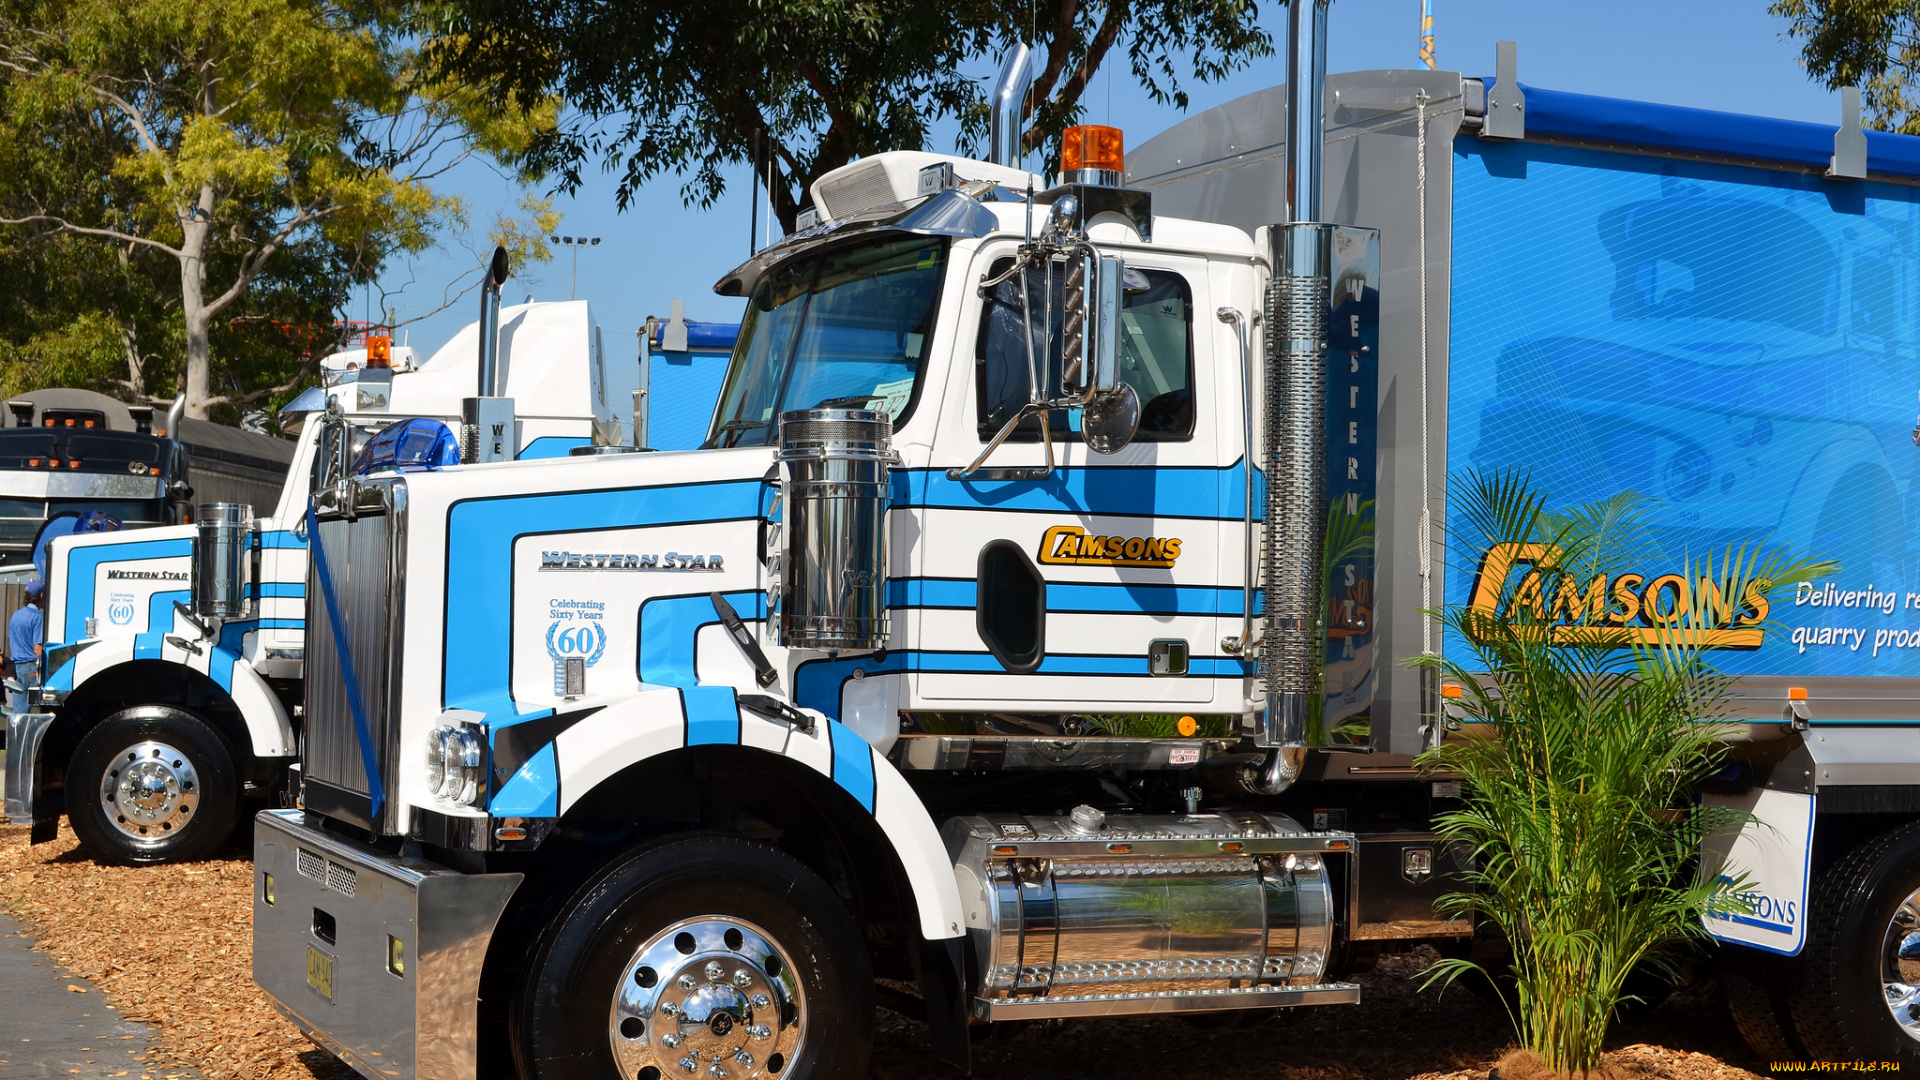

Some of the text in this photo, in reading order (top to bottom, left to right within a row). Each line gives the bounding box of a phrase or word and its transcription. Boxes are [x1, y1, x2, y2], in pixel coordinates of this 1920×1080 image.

[1345, 278, 1364, 515] WESTERN
[1037, 525, 1183, 569] CAMSONS
[541, 551, 725, 572] WESTERN STAR
[107, 570, 189, 581] WESTERN STAR
[550, 599, 605, 611] Celebrating
[1466, 541, 1773, 649] CAMSONS
[1795, 581, 1897, 615] Delivering
[113, 606, 130, 619] 60
[550, 610, 604, 621] Sixty Years
[558, 627, 594, 654] 60
[1791, 627, 1867, 654] quarry
